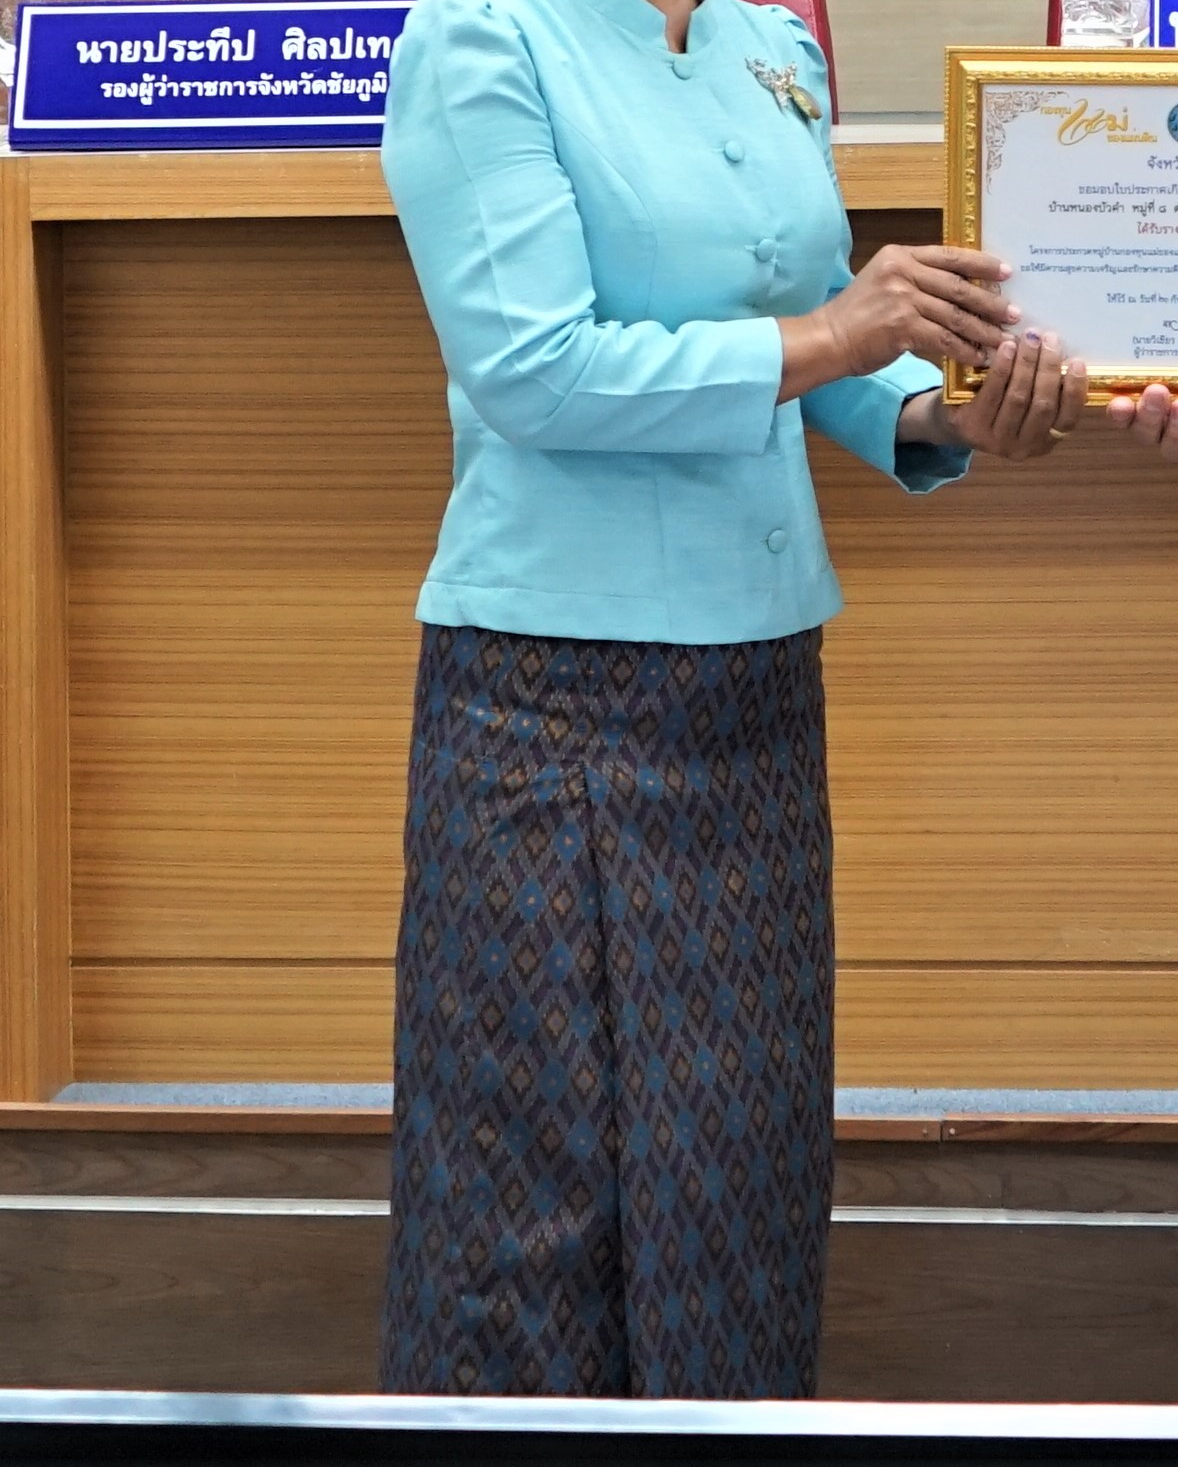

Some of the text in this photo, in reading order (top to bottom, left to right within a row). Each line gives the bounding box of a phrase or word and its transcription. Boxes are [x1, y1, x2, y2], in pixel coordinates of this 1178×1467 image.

[76, 26, 391, 63] นายประทีป ศิลปเท
[101, 72, 388, 105] รองผู้ว่าราชการจังหวัดชัยภูมิ
